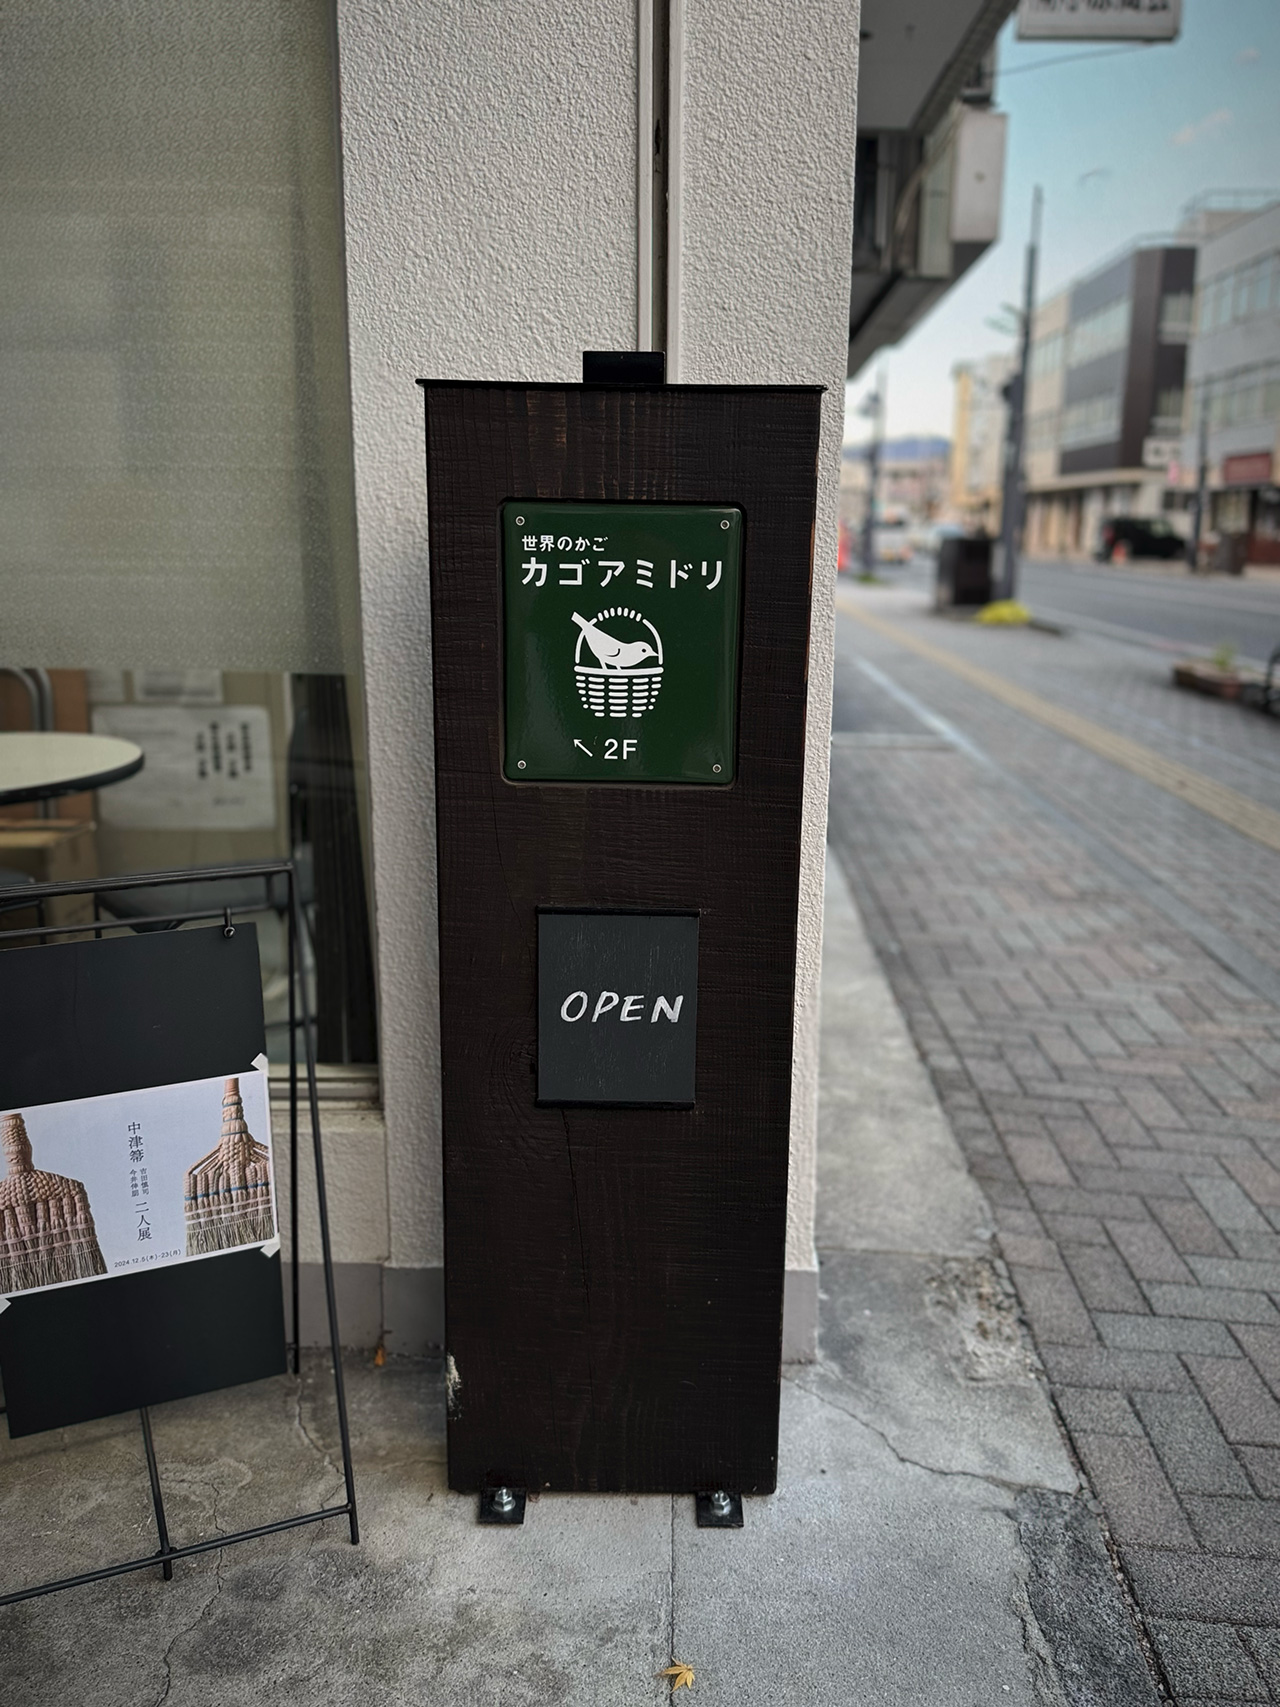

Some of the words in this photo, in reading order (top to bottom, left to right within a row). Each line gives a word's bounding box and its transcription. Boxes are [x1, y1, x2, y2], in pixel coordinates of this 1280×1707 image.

[522, 534, 608, 552] 世界のかご
[521, 556, 723, 590] カゴアミドリ
[604, 738, 638, 760] 2F
[560, 990, 684, 1023] OPEN
[135, 1202, 152, 1241] 二人展
